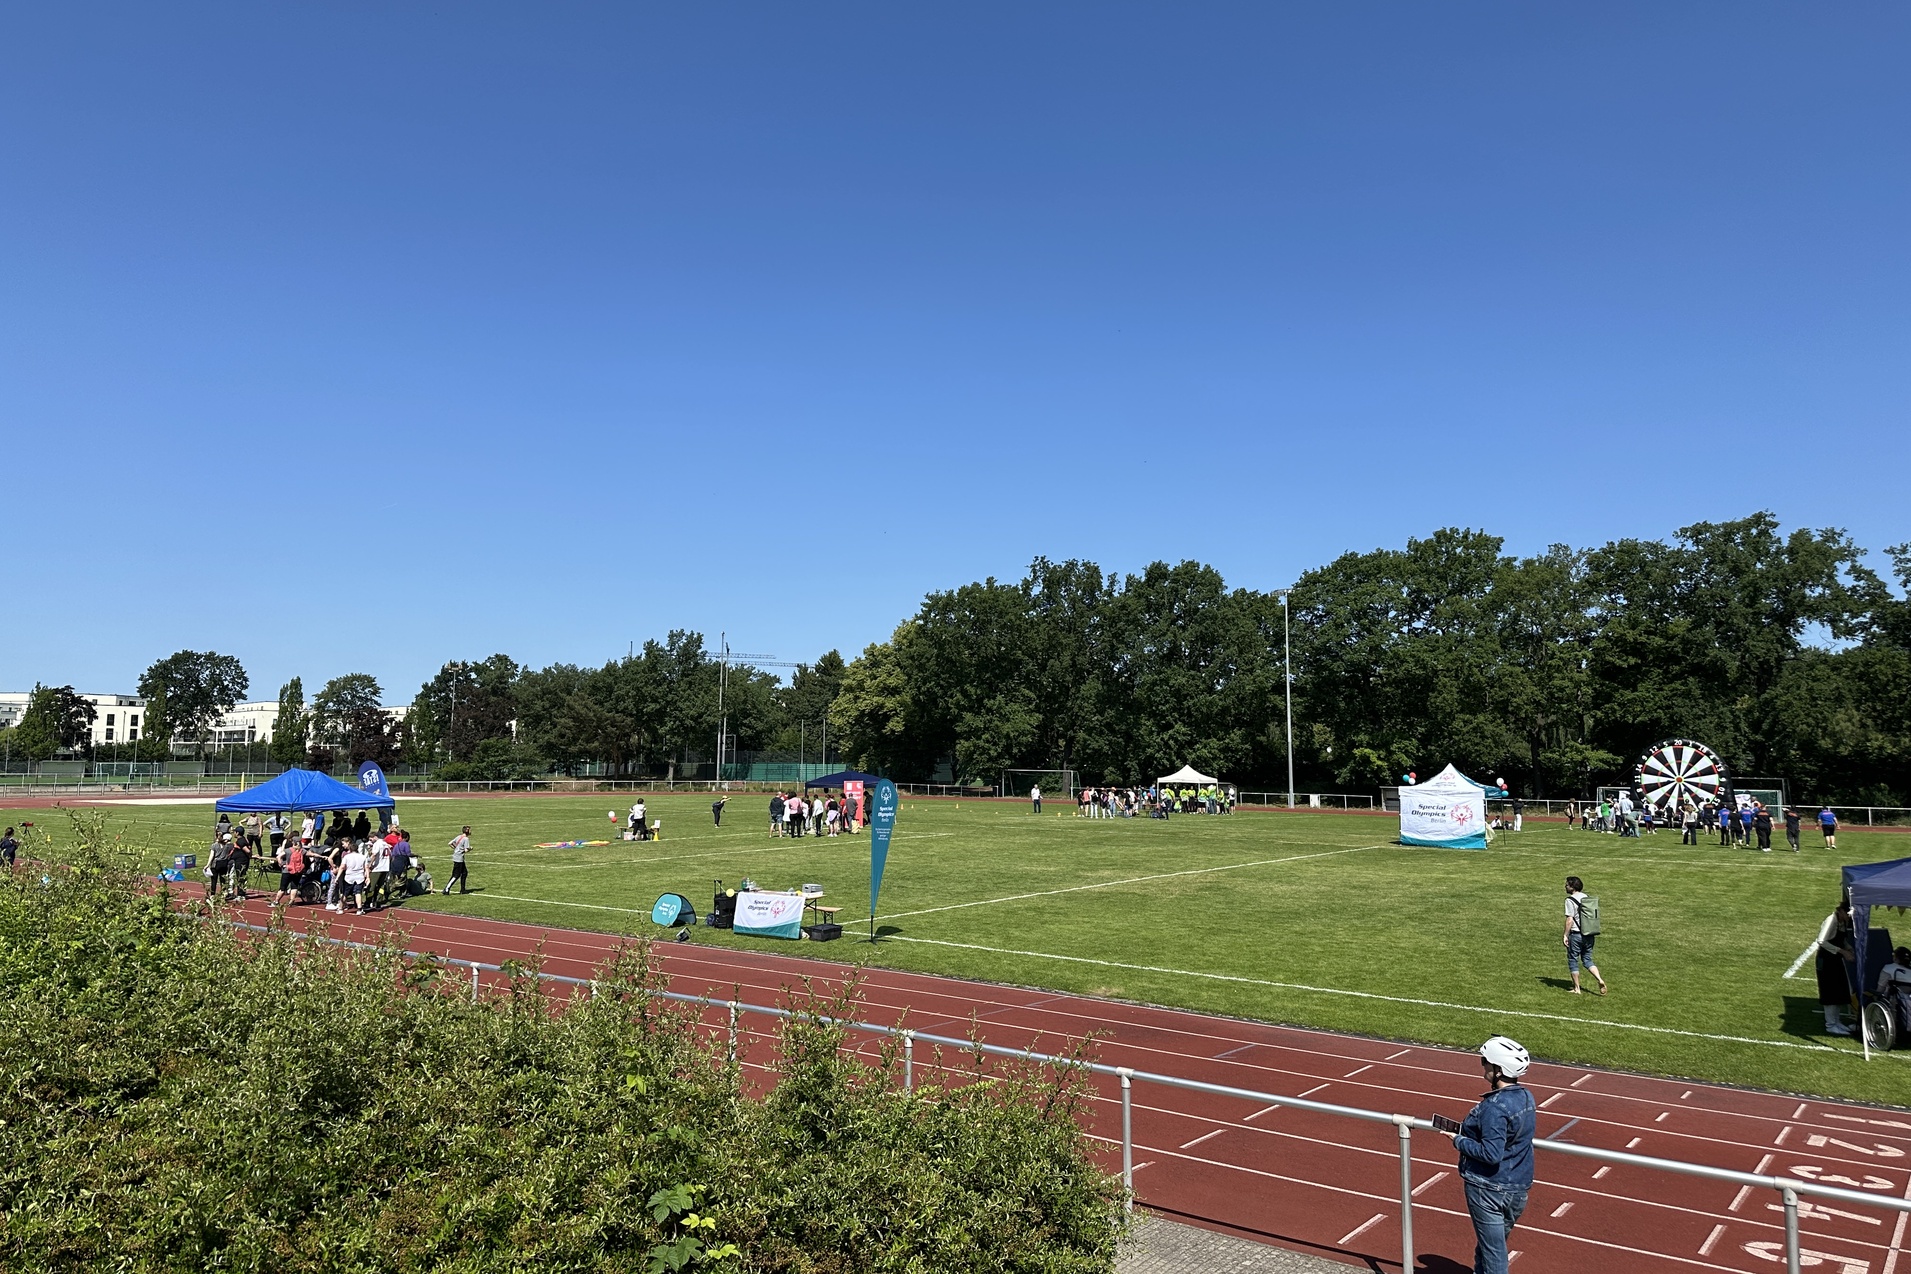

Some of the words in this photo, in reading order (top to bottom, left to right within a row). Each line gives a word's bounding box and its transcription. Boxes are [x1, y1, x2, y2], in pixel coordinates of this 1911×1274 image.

[1650, 746, 1658, 754] 12
[1636, 764, 1643, 772] 14
[1716, 764, 1724, 772] 13
[1635, 775, 1641, 783] 11
[1719, 787, 1726, 796] 10
[1713, 798, 1721, 806] 15
[1804, 1133, 1906, 1157] 2
[1788, 1165, 1895, 1190] 3
[1765, 1200, 1882, 1226] 4
[1740, 1241, 1870, 1274] 5
